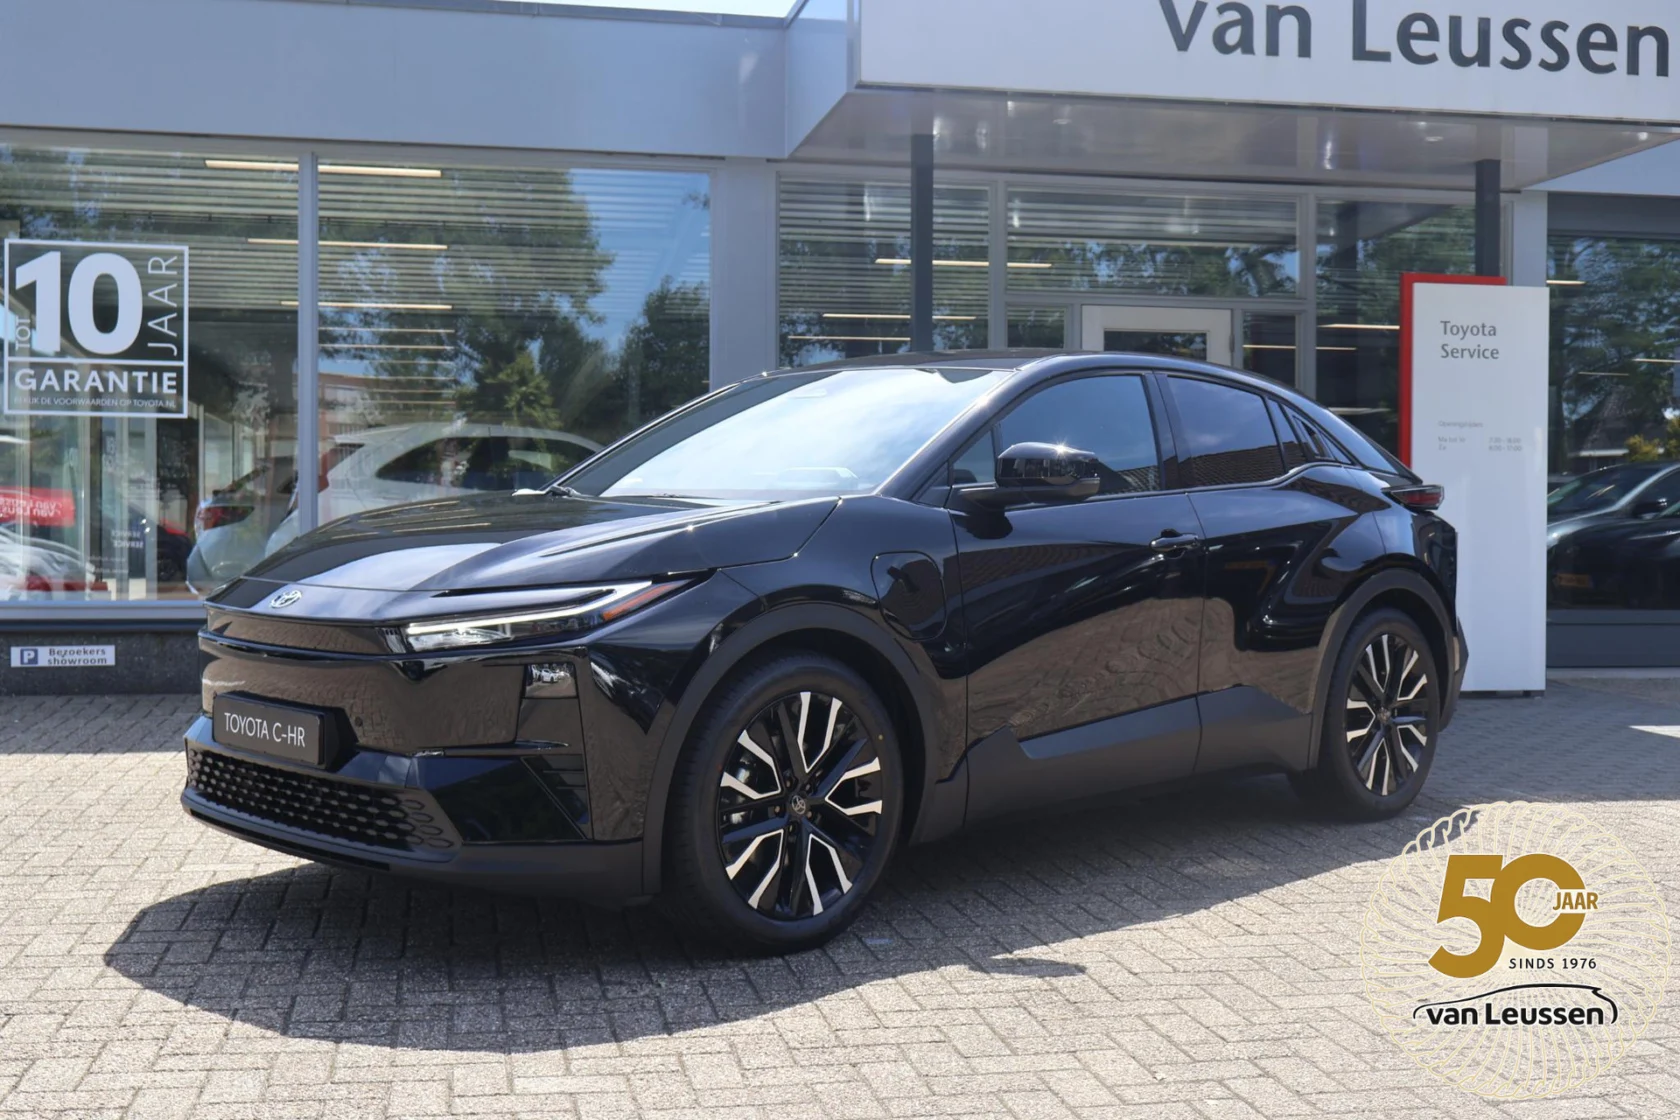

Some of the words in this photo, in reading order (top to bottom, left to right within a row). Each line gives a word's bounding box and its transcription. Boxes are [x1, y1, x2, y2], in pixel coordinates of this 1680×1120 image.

[1160, 0, 1312, 58] van
[1351, 0, 1669, 77] Leussen
[15, 250, 143, 355] 10
[147, 255, 178, 357] JAAR
[15, 315, 31, 352] TOT
[1440, 320, 1497, 340] Toyota
[1440, 343, 1500, 360] Service
[14, 368, 177, 394] GARANTIE
[53, 397, 118, 407] VOORWAARDEN
[119, 399, 133, 407] OP
[47, 657, 107, 665] showroom
[48, 648, 106, 657] Bezoekers
[224, 712, 269, 740] TOYOTA
[272, 722, 305, 748] C-HR
